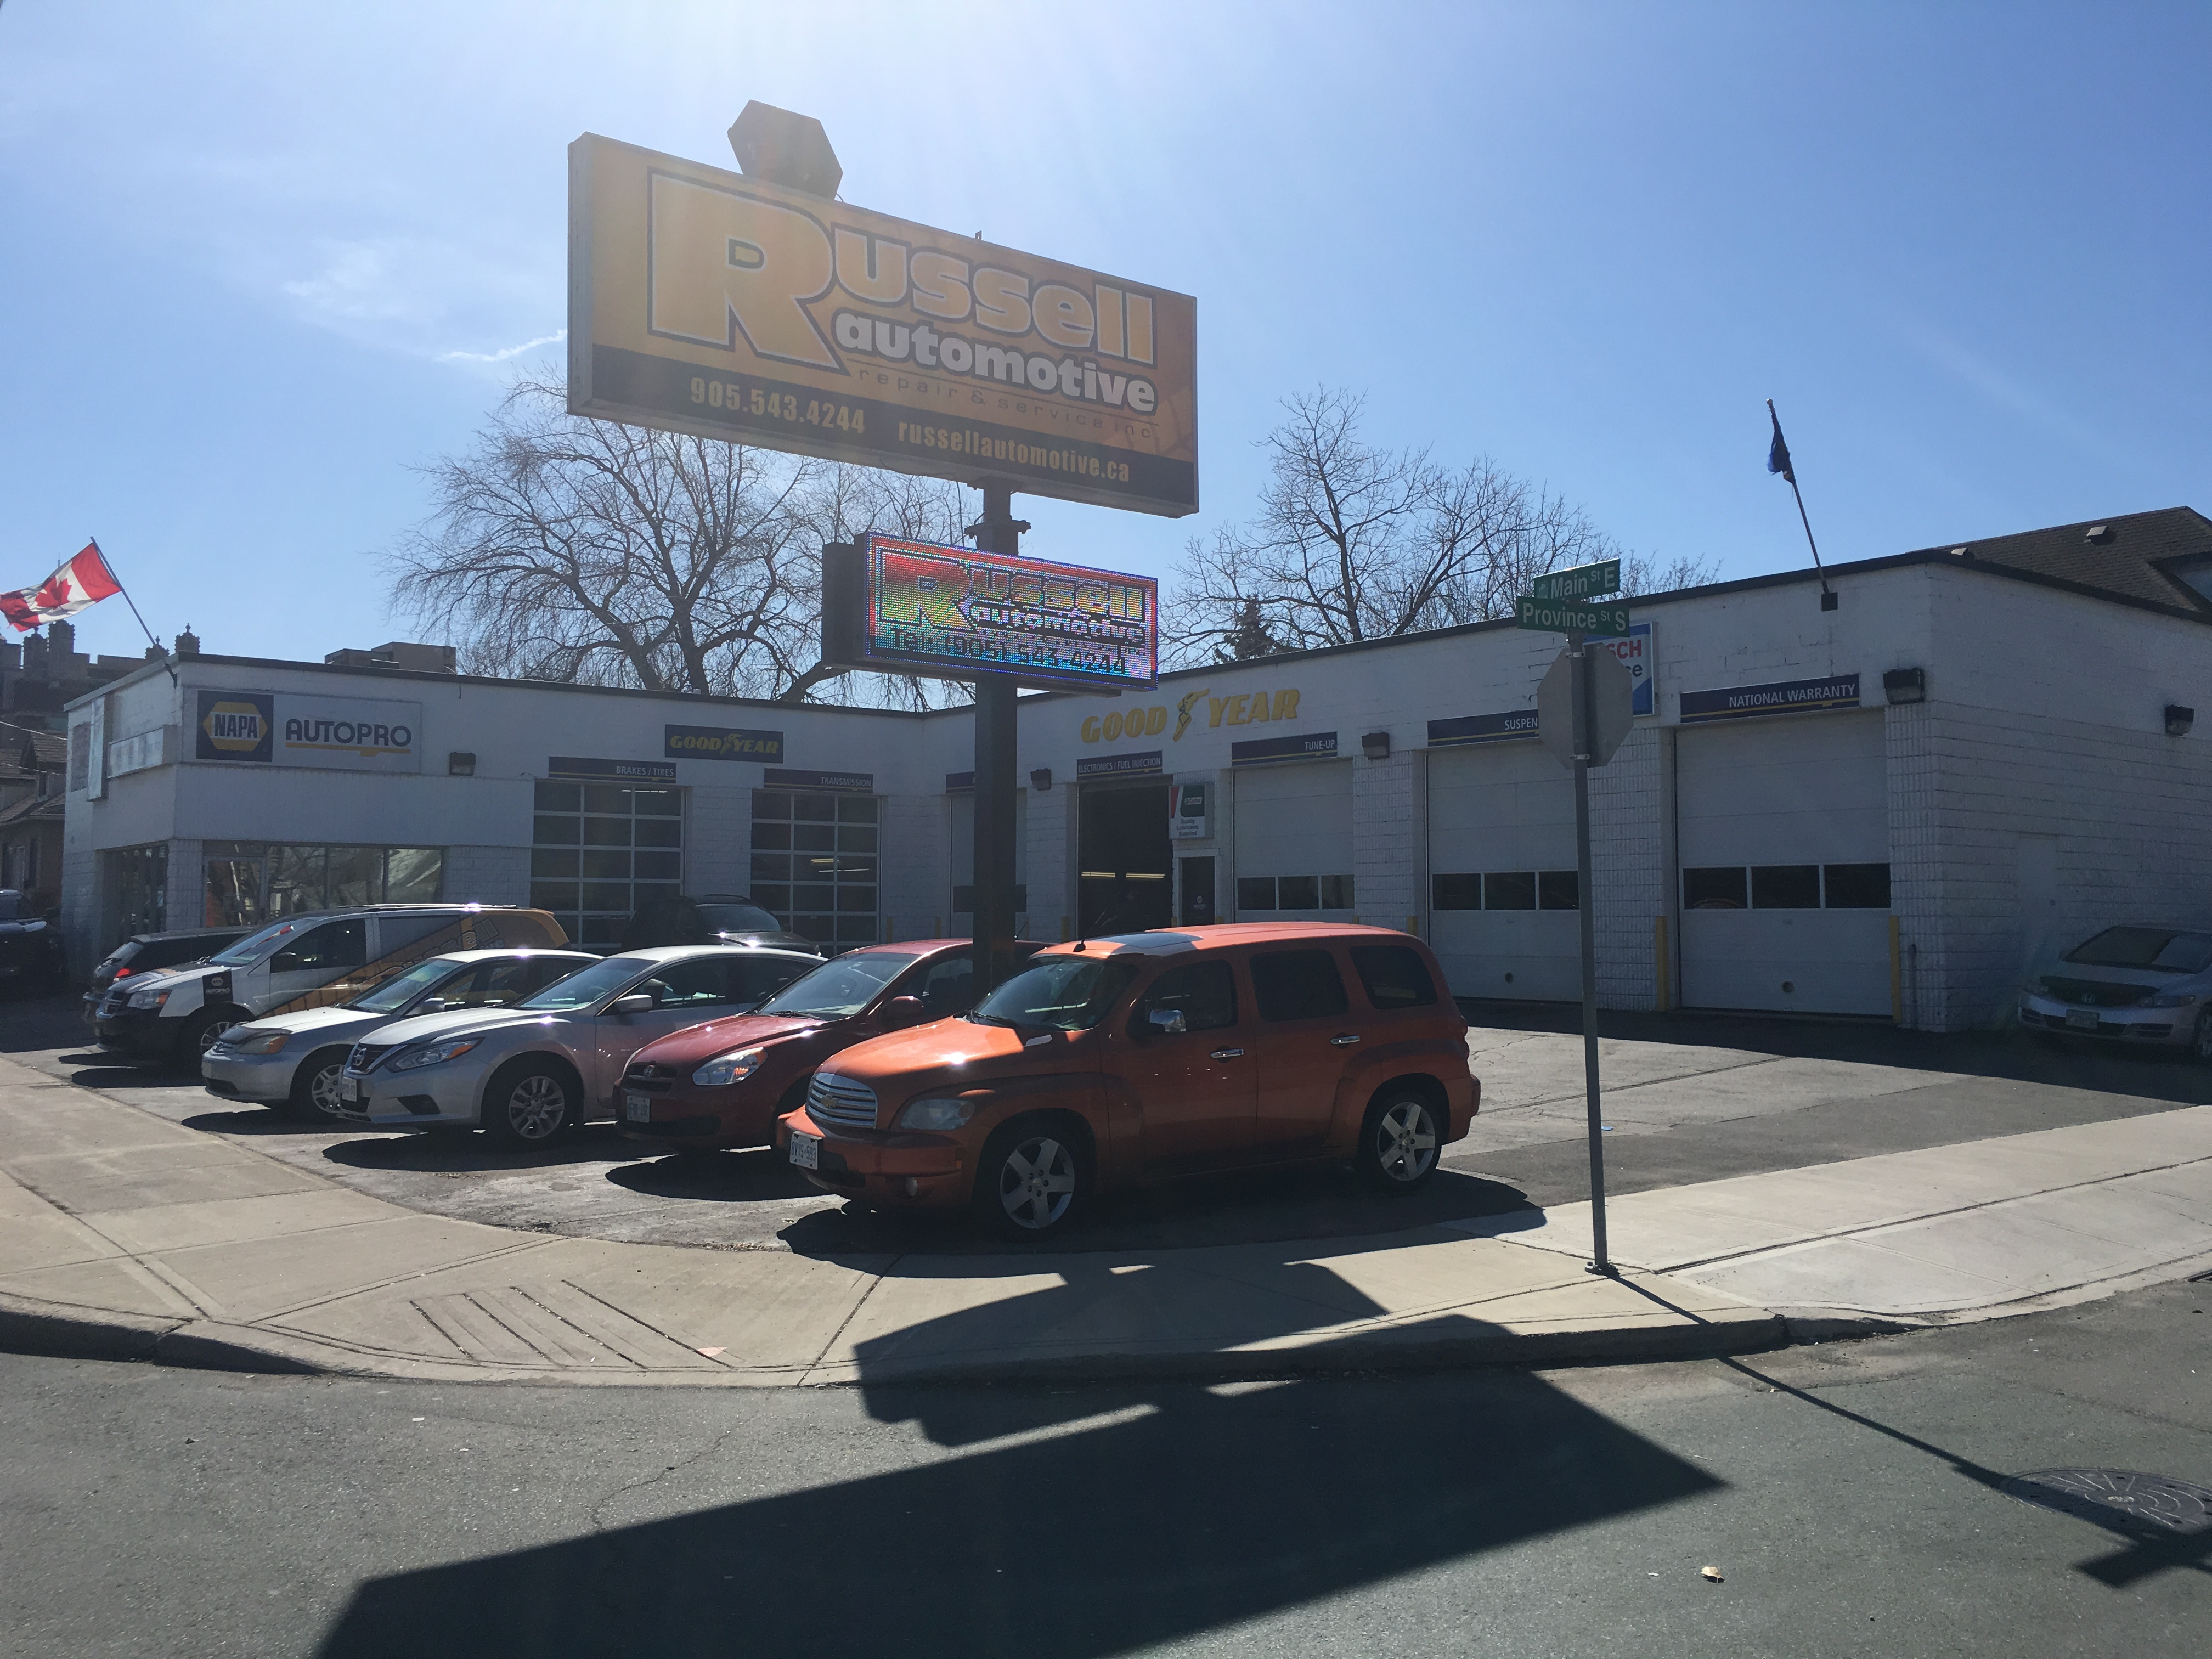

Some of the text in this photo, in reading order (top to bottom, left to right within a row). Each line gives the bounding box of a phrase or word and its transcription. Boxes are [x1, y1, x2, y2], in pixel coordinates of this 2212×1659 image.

[648, 167, 1157, 376] Russell
[832, 308, 1158, 415] automotive
[690, 376, 865, 434] 905.543.4244
[859, 369, 958, 399] repair
[970, 391, 986, 405] &
[997, 397, 1103, 429] service
[898, 421, 1130, 483] russellautomotive.ca
[880, 549, 1146, 632] Russell
[1550, 566, 1616, 599] Main St E
[970, 606, 1144, 643] automotive
[1523, 602, 1626, 631] Province St S
[1729, 684, 1855, 708] NATIONAL WARRANTY
[214, 714, 258, 739] NAPA
[285, 718, 412, 747] AUTOPRO
[1504, 716, 1538, 730] SUSPEN
[1304, 739, 1335, 751] TUNE-UP
[616, 766, 646, 775] BRAKES
[653, 768, 674, 776] TIRES
[1078, 762, 1113, 773] ELECTRONICS
[1118, 760, 1130, 769] FUEL
[1132, 758, 1161, 768] INJECTION
[820, 776, 872, 787] TRANSMISSION
